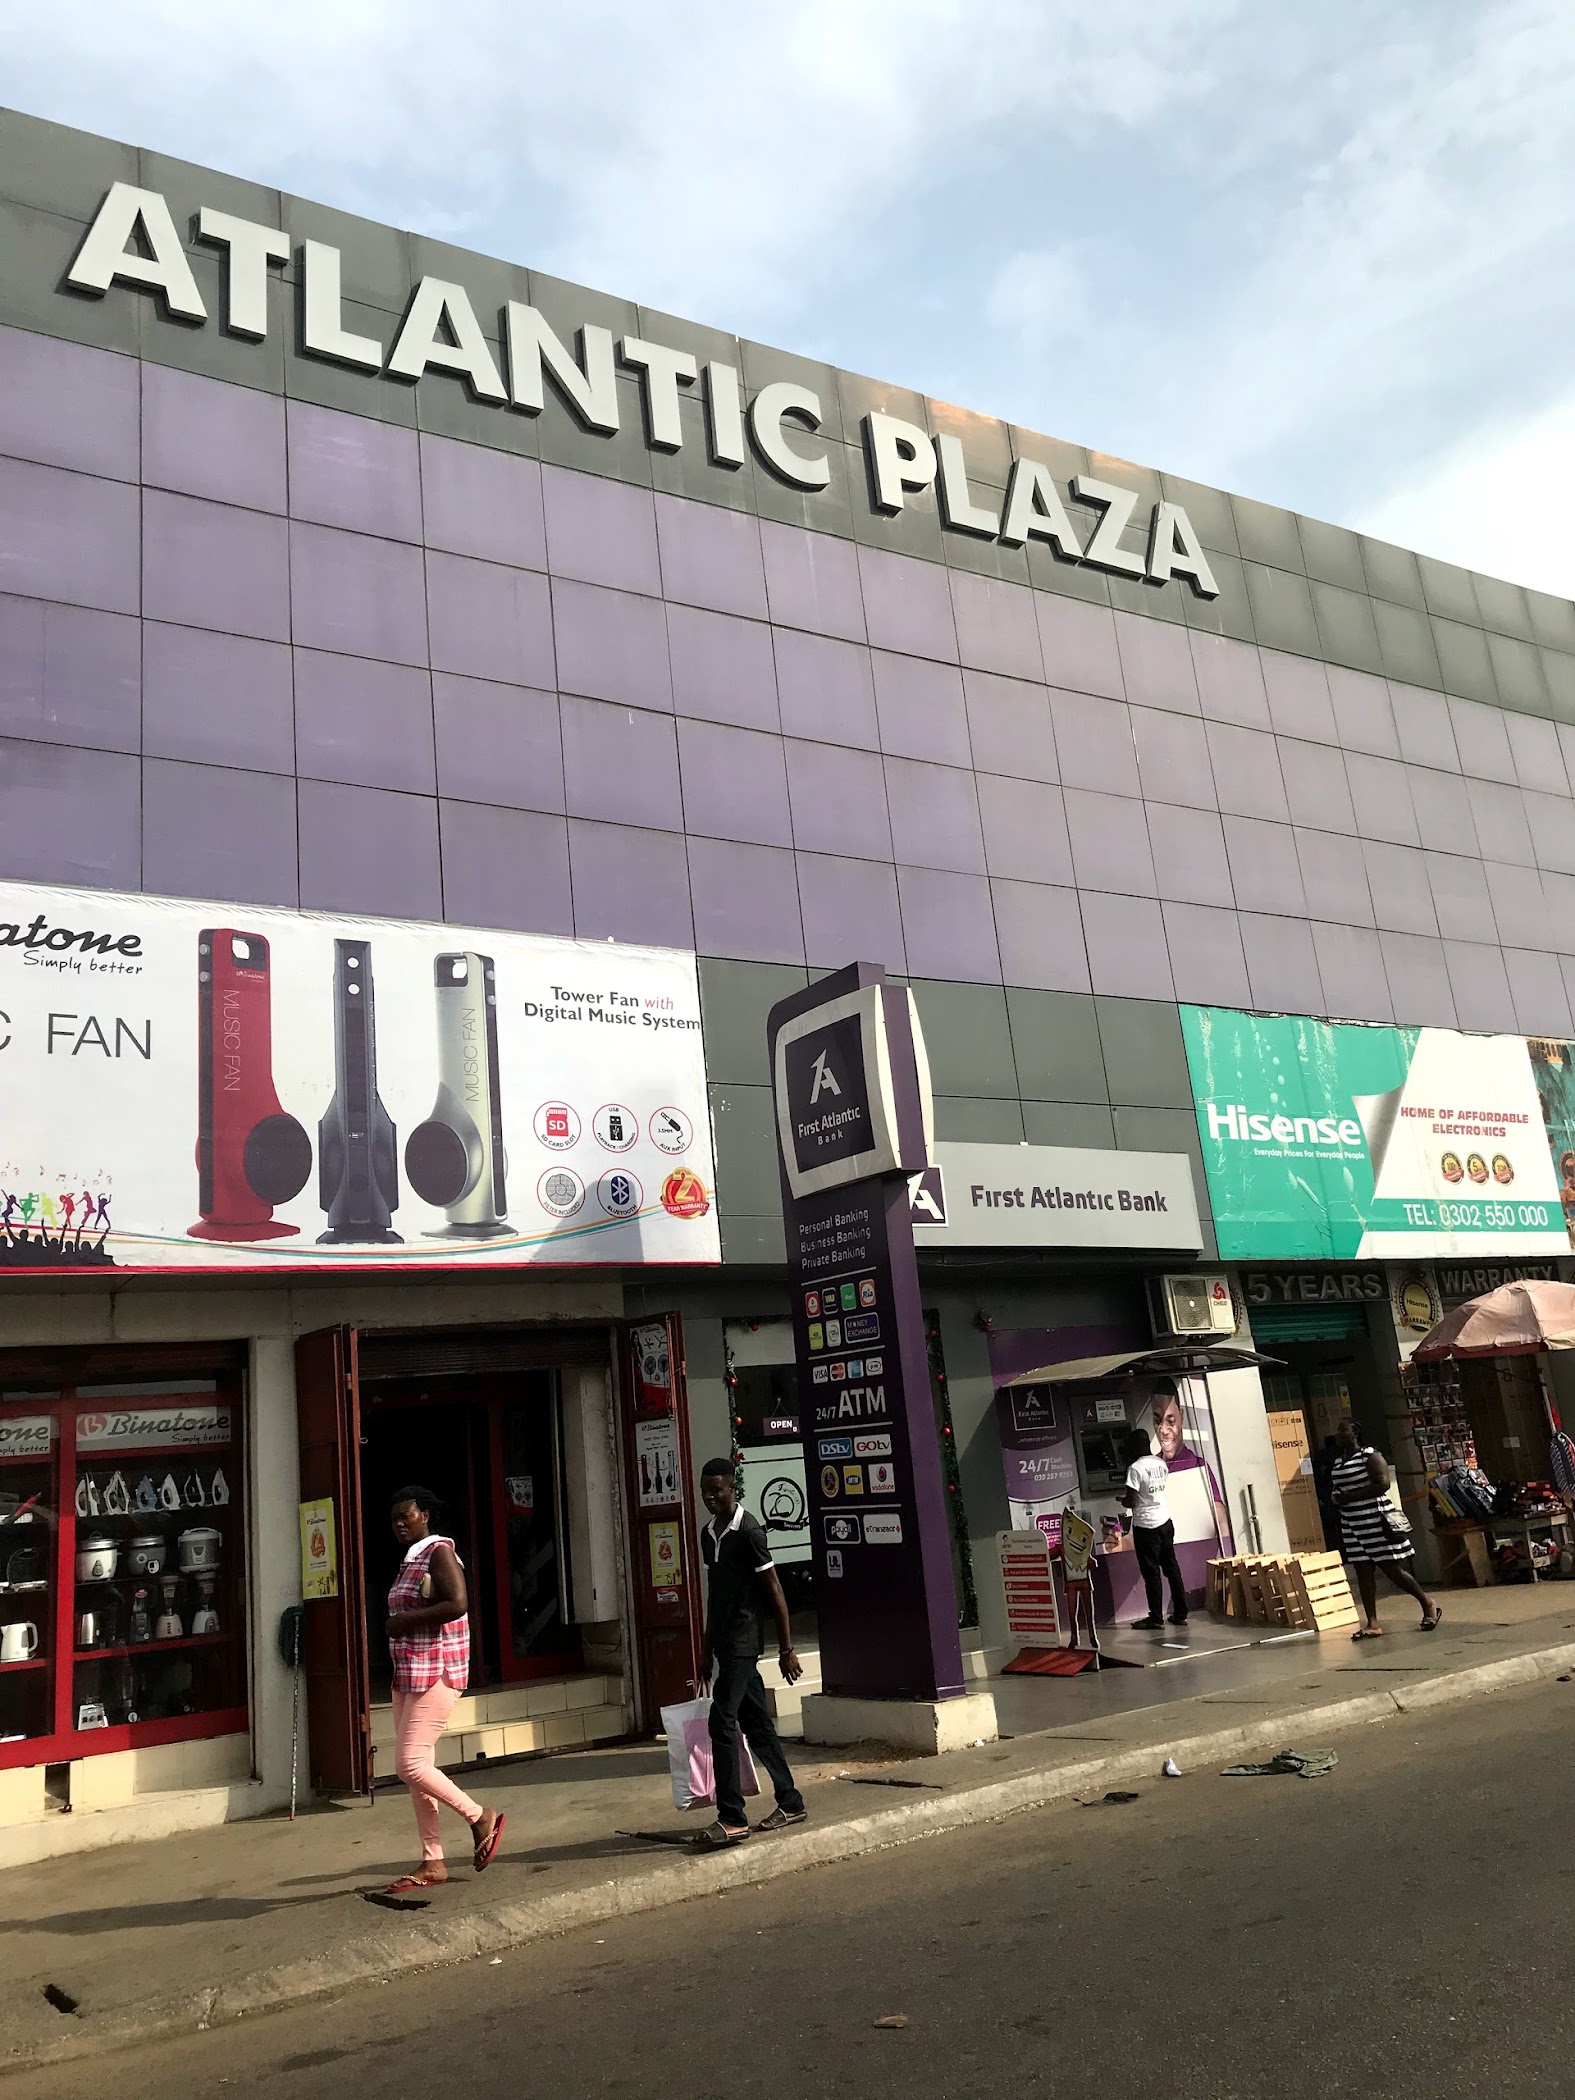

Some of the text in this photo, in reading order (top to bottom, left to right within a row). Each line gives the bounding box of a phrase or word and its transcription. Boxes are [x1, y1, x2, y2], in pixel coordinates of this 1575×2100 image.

[66, 181, 1220, 600] ATLANTIC PLAZA
[23, 950, 143, 974] Simply better
[551, 986, 674, 1010] Tower Fan with
[524, 1002, 700, 1031] Digital Music System
[47, 1013, 151, 1060] FAN
[223, 989, 241, 1091] MUSIC FAN
[462, 1007, 479, 1102] MUSIC FAN
[549, 1120, 566, 1130] SD
[798, 1106, 861, 1138] First Atlantic
[1207, 1103, 1361, 1145] Hisense
[1401, 1107, 1529, 1123] HOME OF AFFORDABLE
[548, 1140, 564, 1148] CARD
[564, 1134, 576, 1147] SLOT
[817, 1129, 843, 1145] Bank
[1432, 1123, 1506, 1137] ELECTRONICS
[659, 1142, 685, 1152] AUX INPUT
[1254, 1148, 1282, 1158] Everyday
[1284, 1149, 1303, 1157] Prices
[1316, 1150, 1343, 1159] Everyday
[1344, 1151, 1365, 1159] People
[673, 1167, 695, 1202] 2
[543, 1201, 580, 1215] FILTER INCLUDED
[970, 1185, 1168, 1212] First Atlantic Bank
[799, 1209, 869, 1235] Personal Banking
[1403, 1203, 1548, 1227] TEL: 0302 550 000
[801, 1226, 871, 1253] Business Banking
[802, 1246, 866, 1269] Private Banking
[1248, 1273, 1272, 1303] 5
[1274, 1273, 1383, 1301] YEARS
[847, 1326, 877, 1337] EXCHANGE
[815, 1369, 828, 1379] VISA
[816, 1385, 886, 1420] 24/7 ATM
[108, 1412, 229, 1436] Binatone
[770, 1420, 793, 1429] OPEN
[172, 1433, 229, 1444] Simply better
[857, 1441, 890, 1452] GOtv
[1019, 1458, 1050, 1474] 24/7
[1038, 1519, 1060, 1529] FREE
